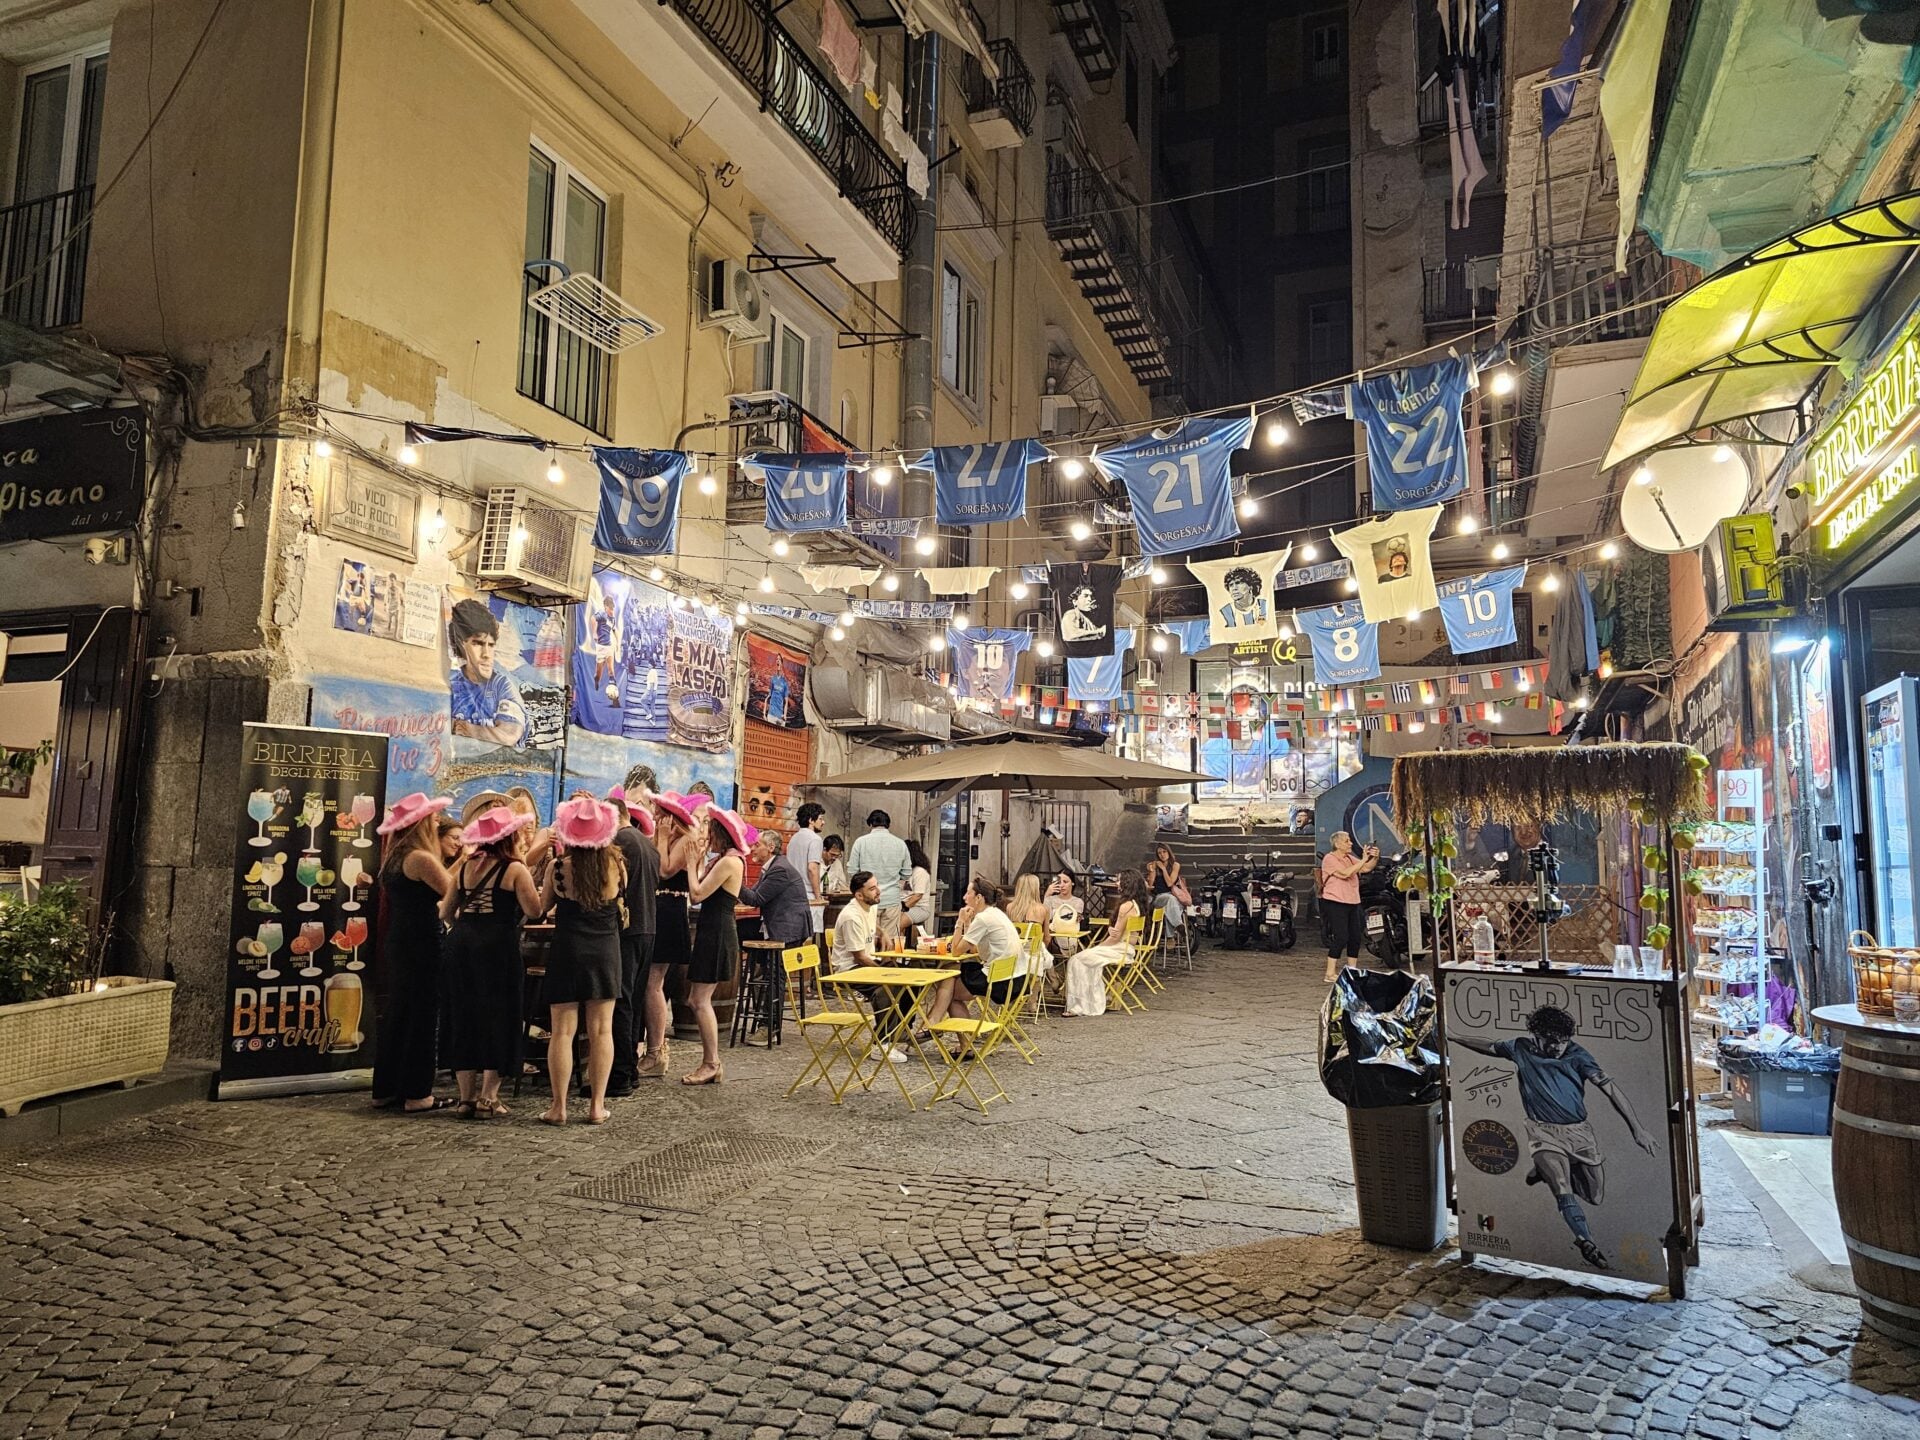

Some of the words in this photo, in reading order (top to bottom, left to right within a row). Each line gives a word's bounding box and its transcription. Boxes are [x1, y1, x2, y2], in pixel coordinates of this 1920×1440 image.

[1390, 382, 1440, 415] LORENZO
[1812, 339, 1920, 506] BIRRERIA
[1388, 405, 1454, 474] 22
[957, 441, 1012, 489] 27
[365, 487, 386, 507] VICO
[611, 469, 669, 528] 19
[1147, 453, 1204, 514] 21
[71, 514, 92, 526] dal
[350, 500, 366, 517] DEI
[369, 507, 398, 529] ROCCI
[1458, 590, 1497, 625] 10
[673, 637, 683, 662] E
[973, 644, 1004, 670] 10
[1233, 645, 1268, 655] ARTISTI
[1333, 626, 1359, 662] 8
[253, 742, 376, 768] BIRRERIA
[425, 736, 443, 777] 3
[270, 766, 310, 777] DEGLI
[313, 769, 361, 781] ARTISTI
[1265, 777, 1297, 792] 1960
[232, 985, 321, 1037] BEER
[282, 1020, 341, 1055] craft
[1468, 1081, 1508, 1101] DIEGO
[1467, 1231, 1511, 1247] BIRRERIA
